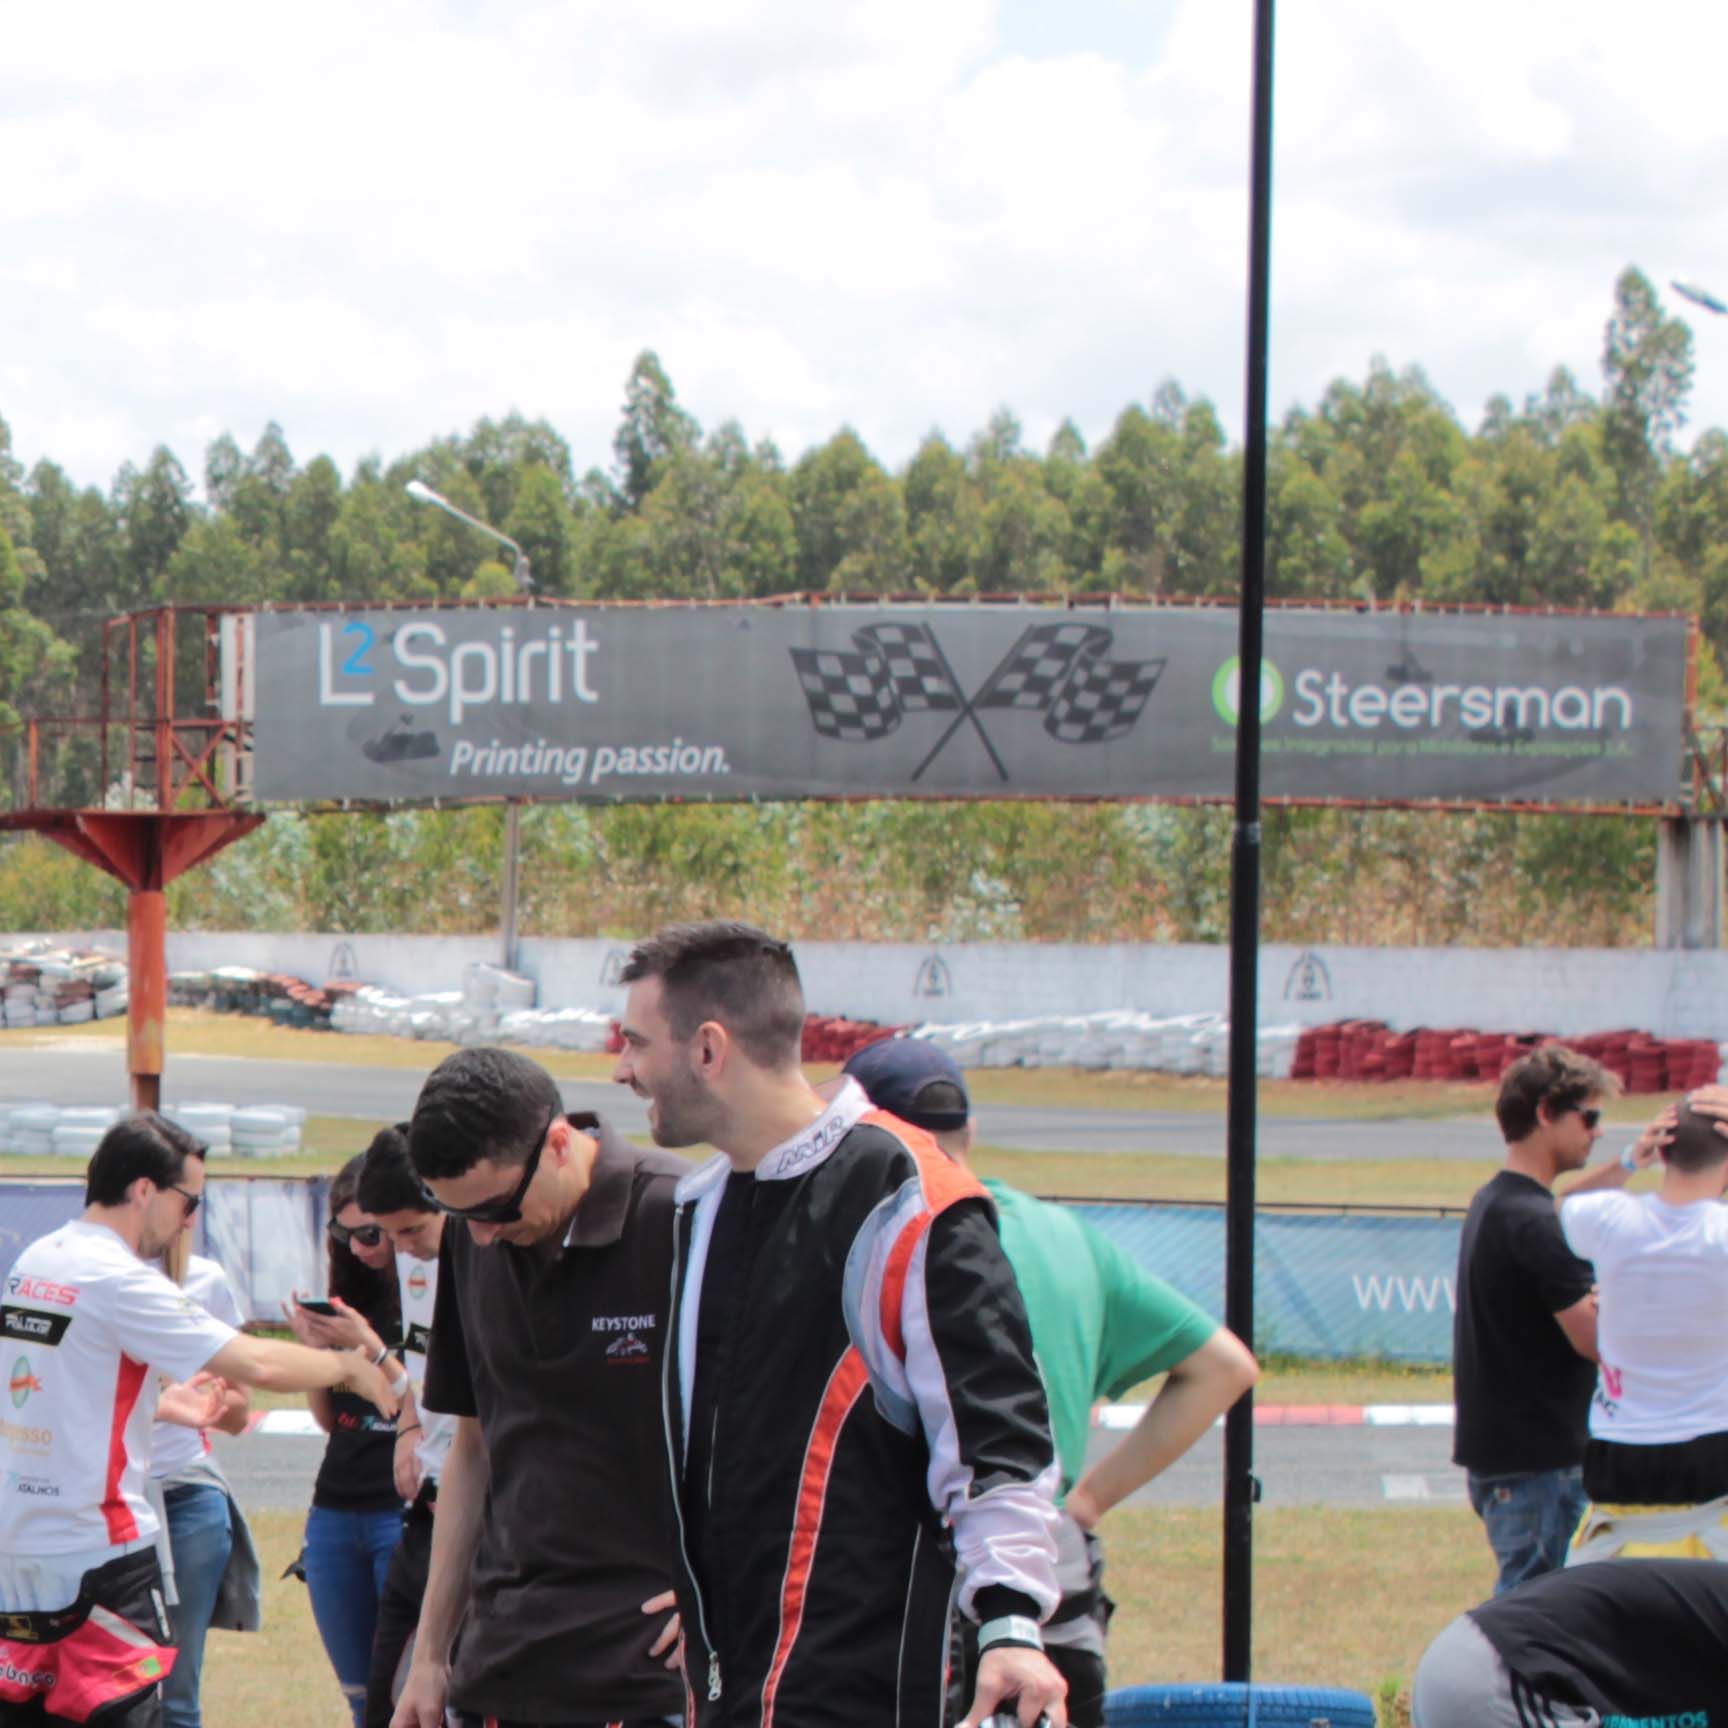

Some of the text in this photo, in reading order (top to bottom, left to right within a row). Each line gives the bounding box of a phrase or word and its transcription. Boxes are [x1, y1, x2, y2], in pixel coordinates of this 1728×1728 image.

[393, 618, 599, 725] Spirit
[1292, 668, 1633, 729] Steersman
[450, 739, 731, 784] Printing passion.
[591, 1314, 656, 1331] KEYSTONE
